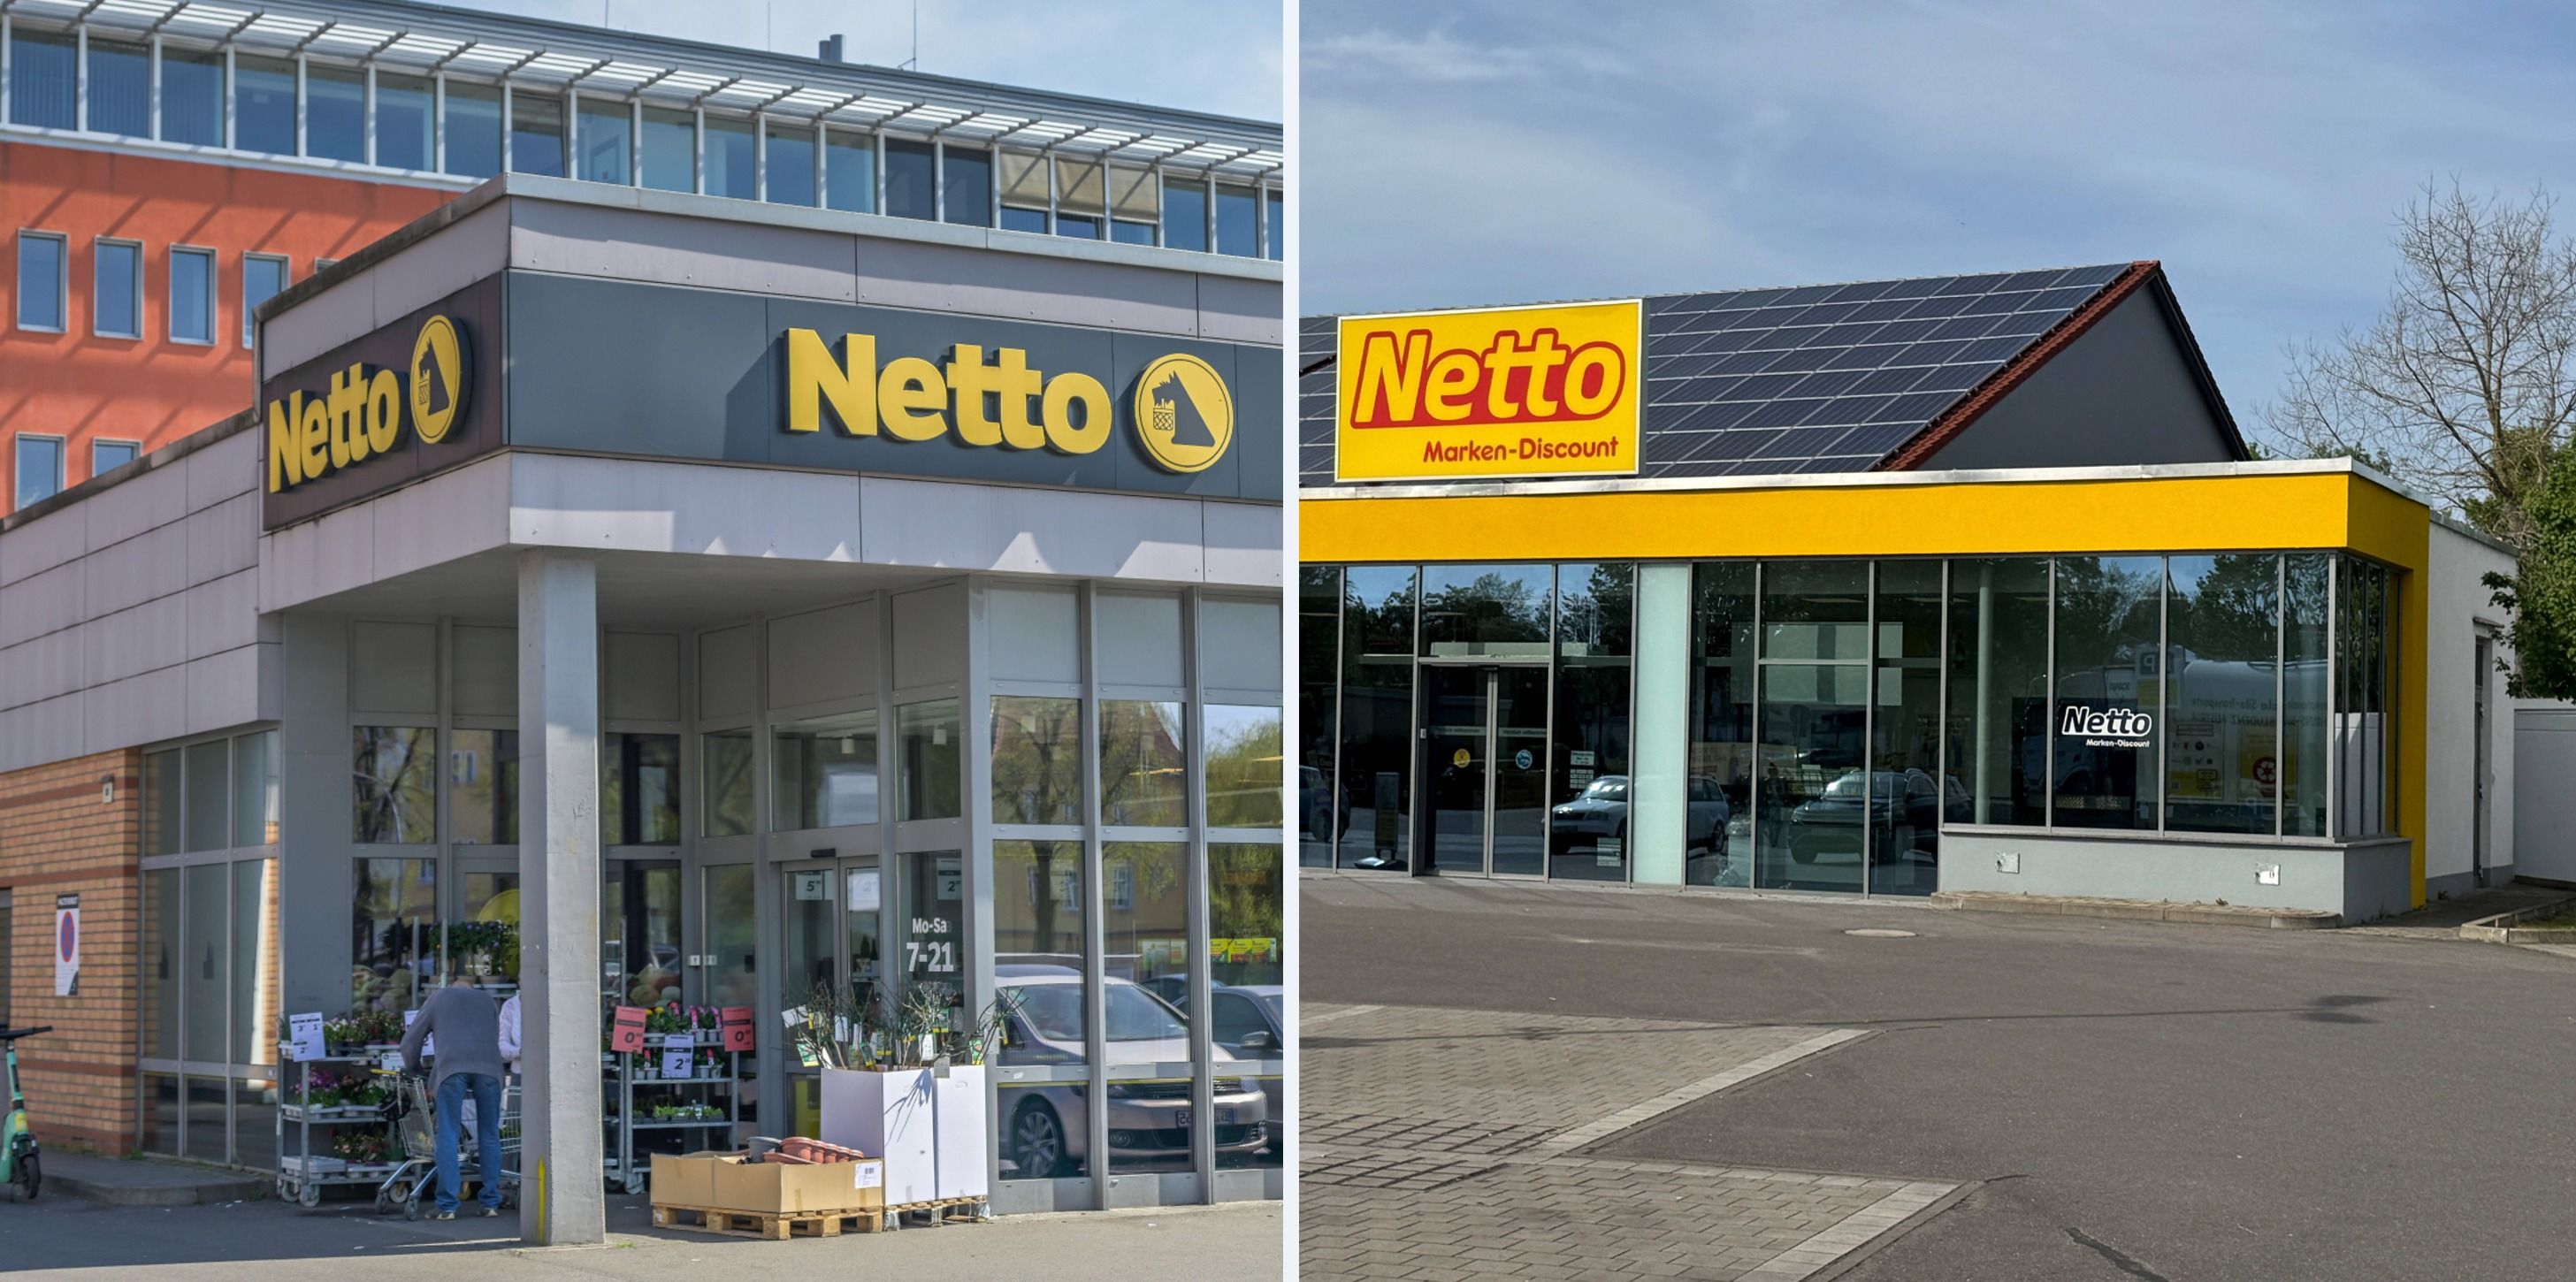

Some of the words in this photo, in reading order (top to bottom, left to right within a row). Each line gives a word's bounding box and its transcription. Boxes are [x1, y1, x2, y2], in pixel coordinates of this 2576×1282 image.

[785, 327, 1112, 454] Netto
[1350, 328, 1625, 429] Netto
[269, 362, 400, 493] Netto
[1423, 436, 1619, 463] Marken-Discount
[2061, 706, 2152, 736] Netto
[2086, 738, 2150, 748] Marken-Discount
[913, 918, 946, 934] Mo-Sa
[906, 942, 954, 973] 7-21
